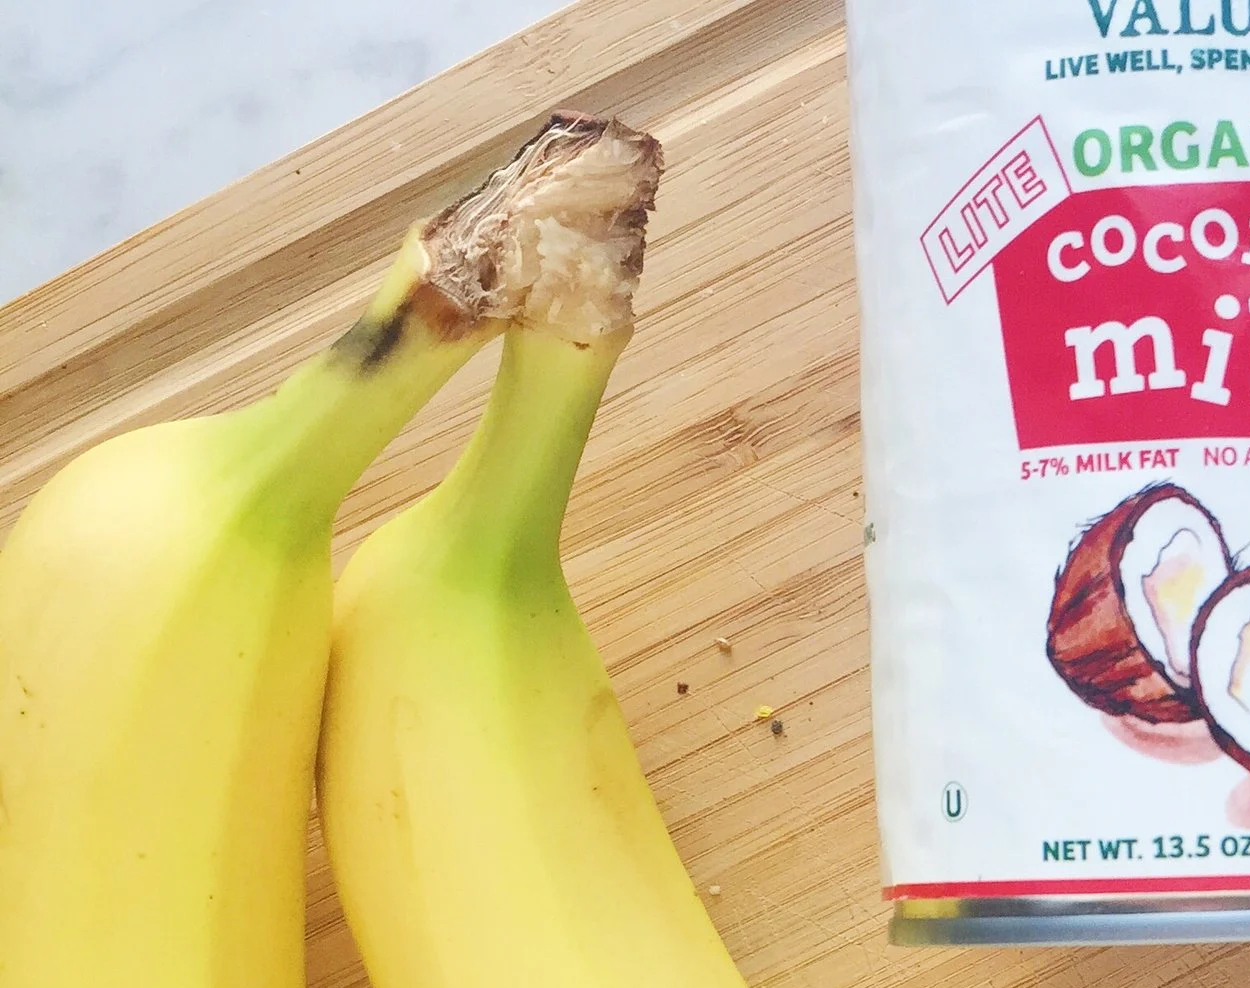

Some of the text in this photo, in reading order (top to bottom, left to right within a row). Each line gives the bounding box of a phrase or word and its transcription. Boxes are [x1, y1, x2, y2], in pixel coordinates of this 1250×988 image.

[1045, 54, 1099, 80] LIVE
[1106, 49, 1183, 74] WELL,
[938, 149, 1048, 270] LITE
[1020, 459, 1070, 481] 5-7%
[1075, 453, 1134, 472] MILK
[1139, 449, 1181, 468] FAT
[1203, 447, 1238, 467] NO
[1042, 840, 1091, 862] NET
[1098, 839, 1142, 860] WT.
[1153, 836, 1210, 858] 13.5
